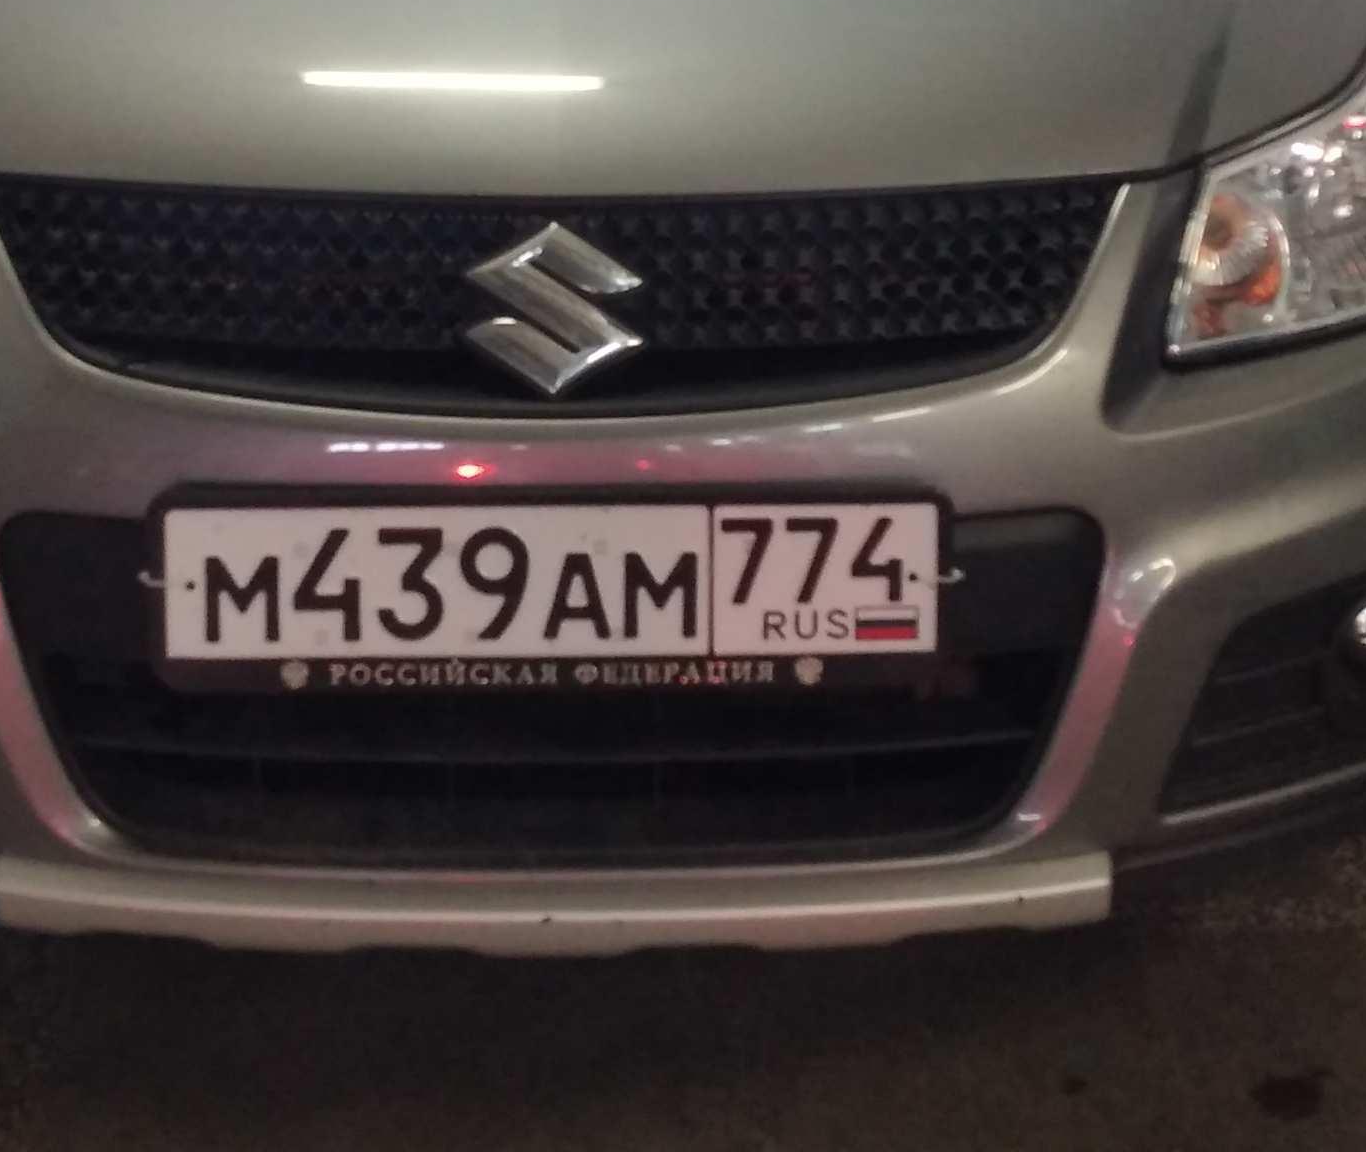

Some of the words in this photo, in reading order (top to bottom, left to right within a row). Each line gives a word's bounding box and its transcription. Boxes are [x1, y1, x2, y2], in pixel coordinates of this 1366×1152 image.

[205, 527, 699, 643] М439АМ
[720, 517, 903, 604] 774
[762, 610, 850, 640] RUS
[329, 657, 559, 686] РОССИЙСКАЯ
[574, 660, 775, 687] ФЕДЕРАЦИЯ
